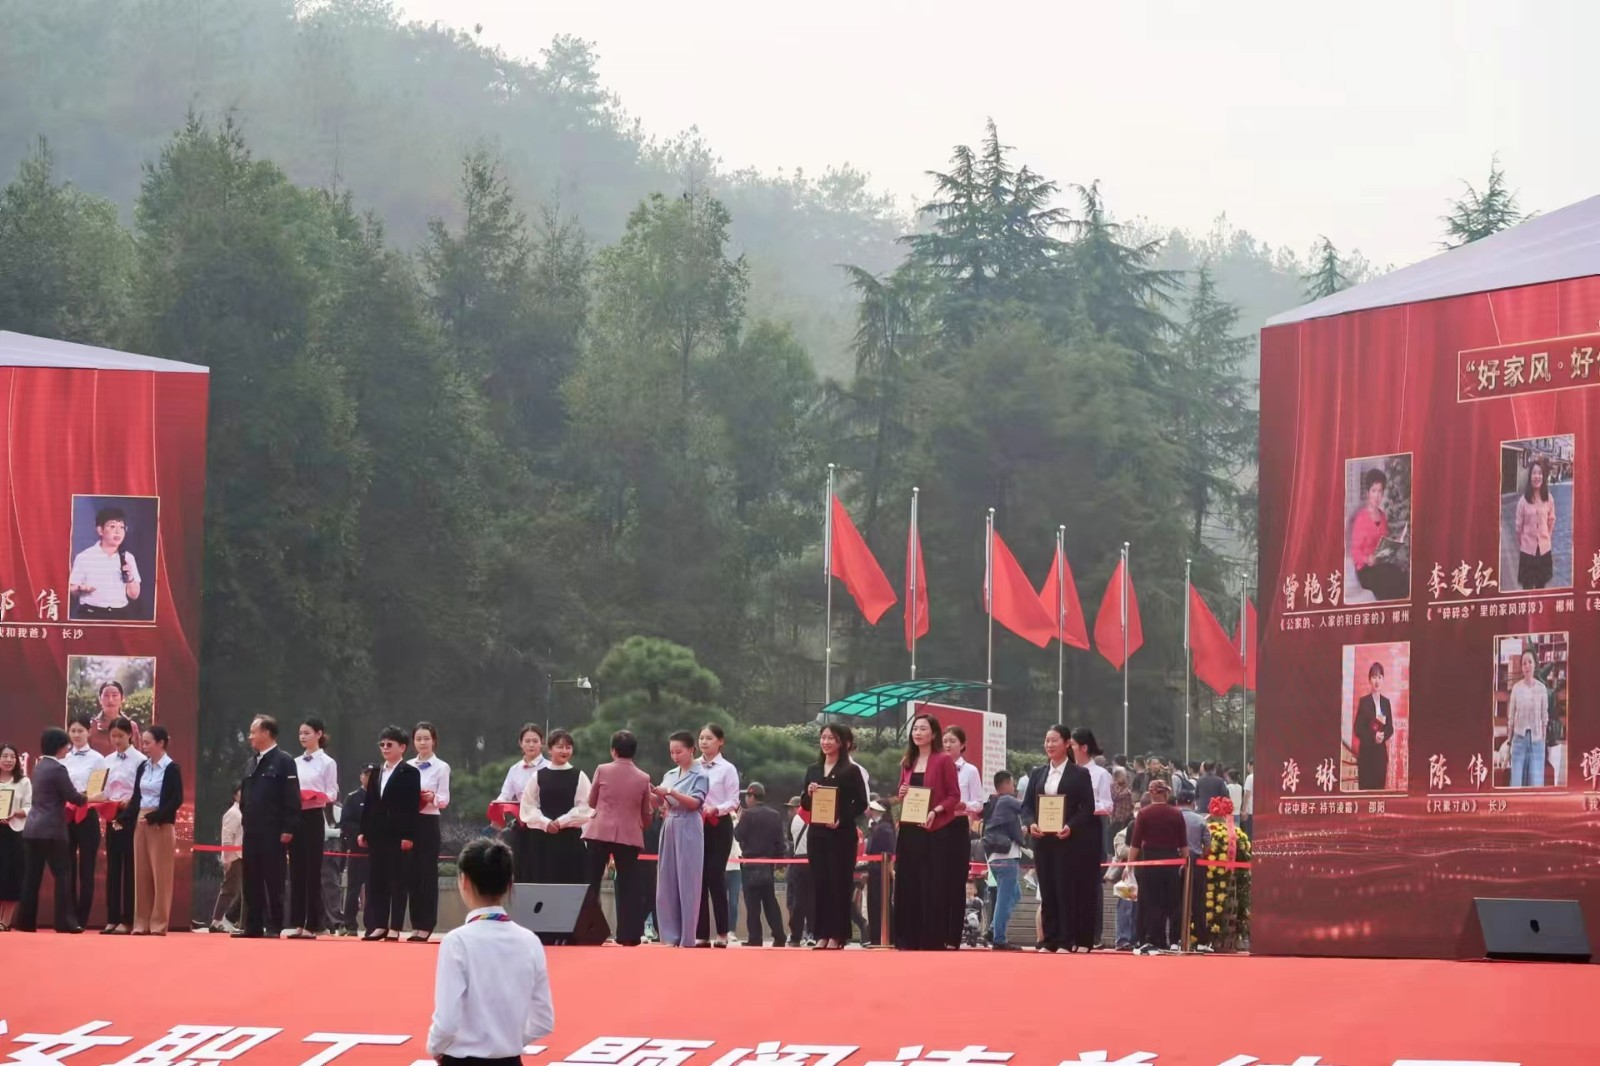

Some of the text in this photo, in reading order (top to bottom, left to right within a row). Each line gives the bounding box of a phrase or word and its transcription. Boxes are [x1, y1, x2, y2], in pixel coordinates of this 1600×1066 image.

[1282, 569, 1342, 611] 曾艳芳
[1427, 559, 1498, 599] 李建红
[62, 628, 83, 640] 长沙
[1429, 753, 1489, 791] 陈伟
[1488, 799, 1507, 812] 长沙
